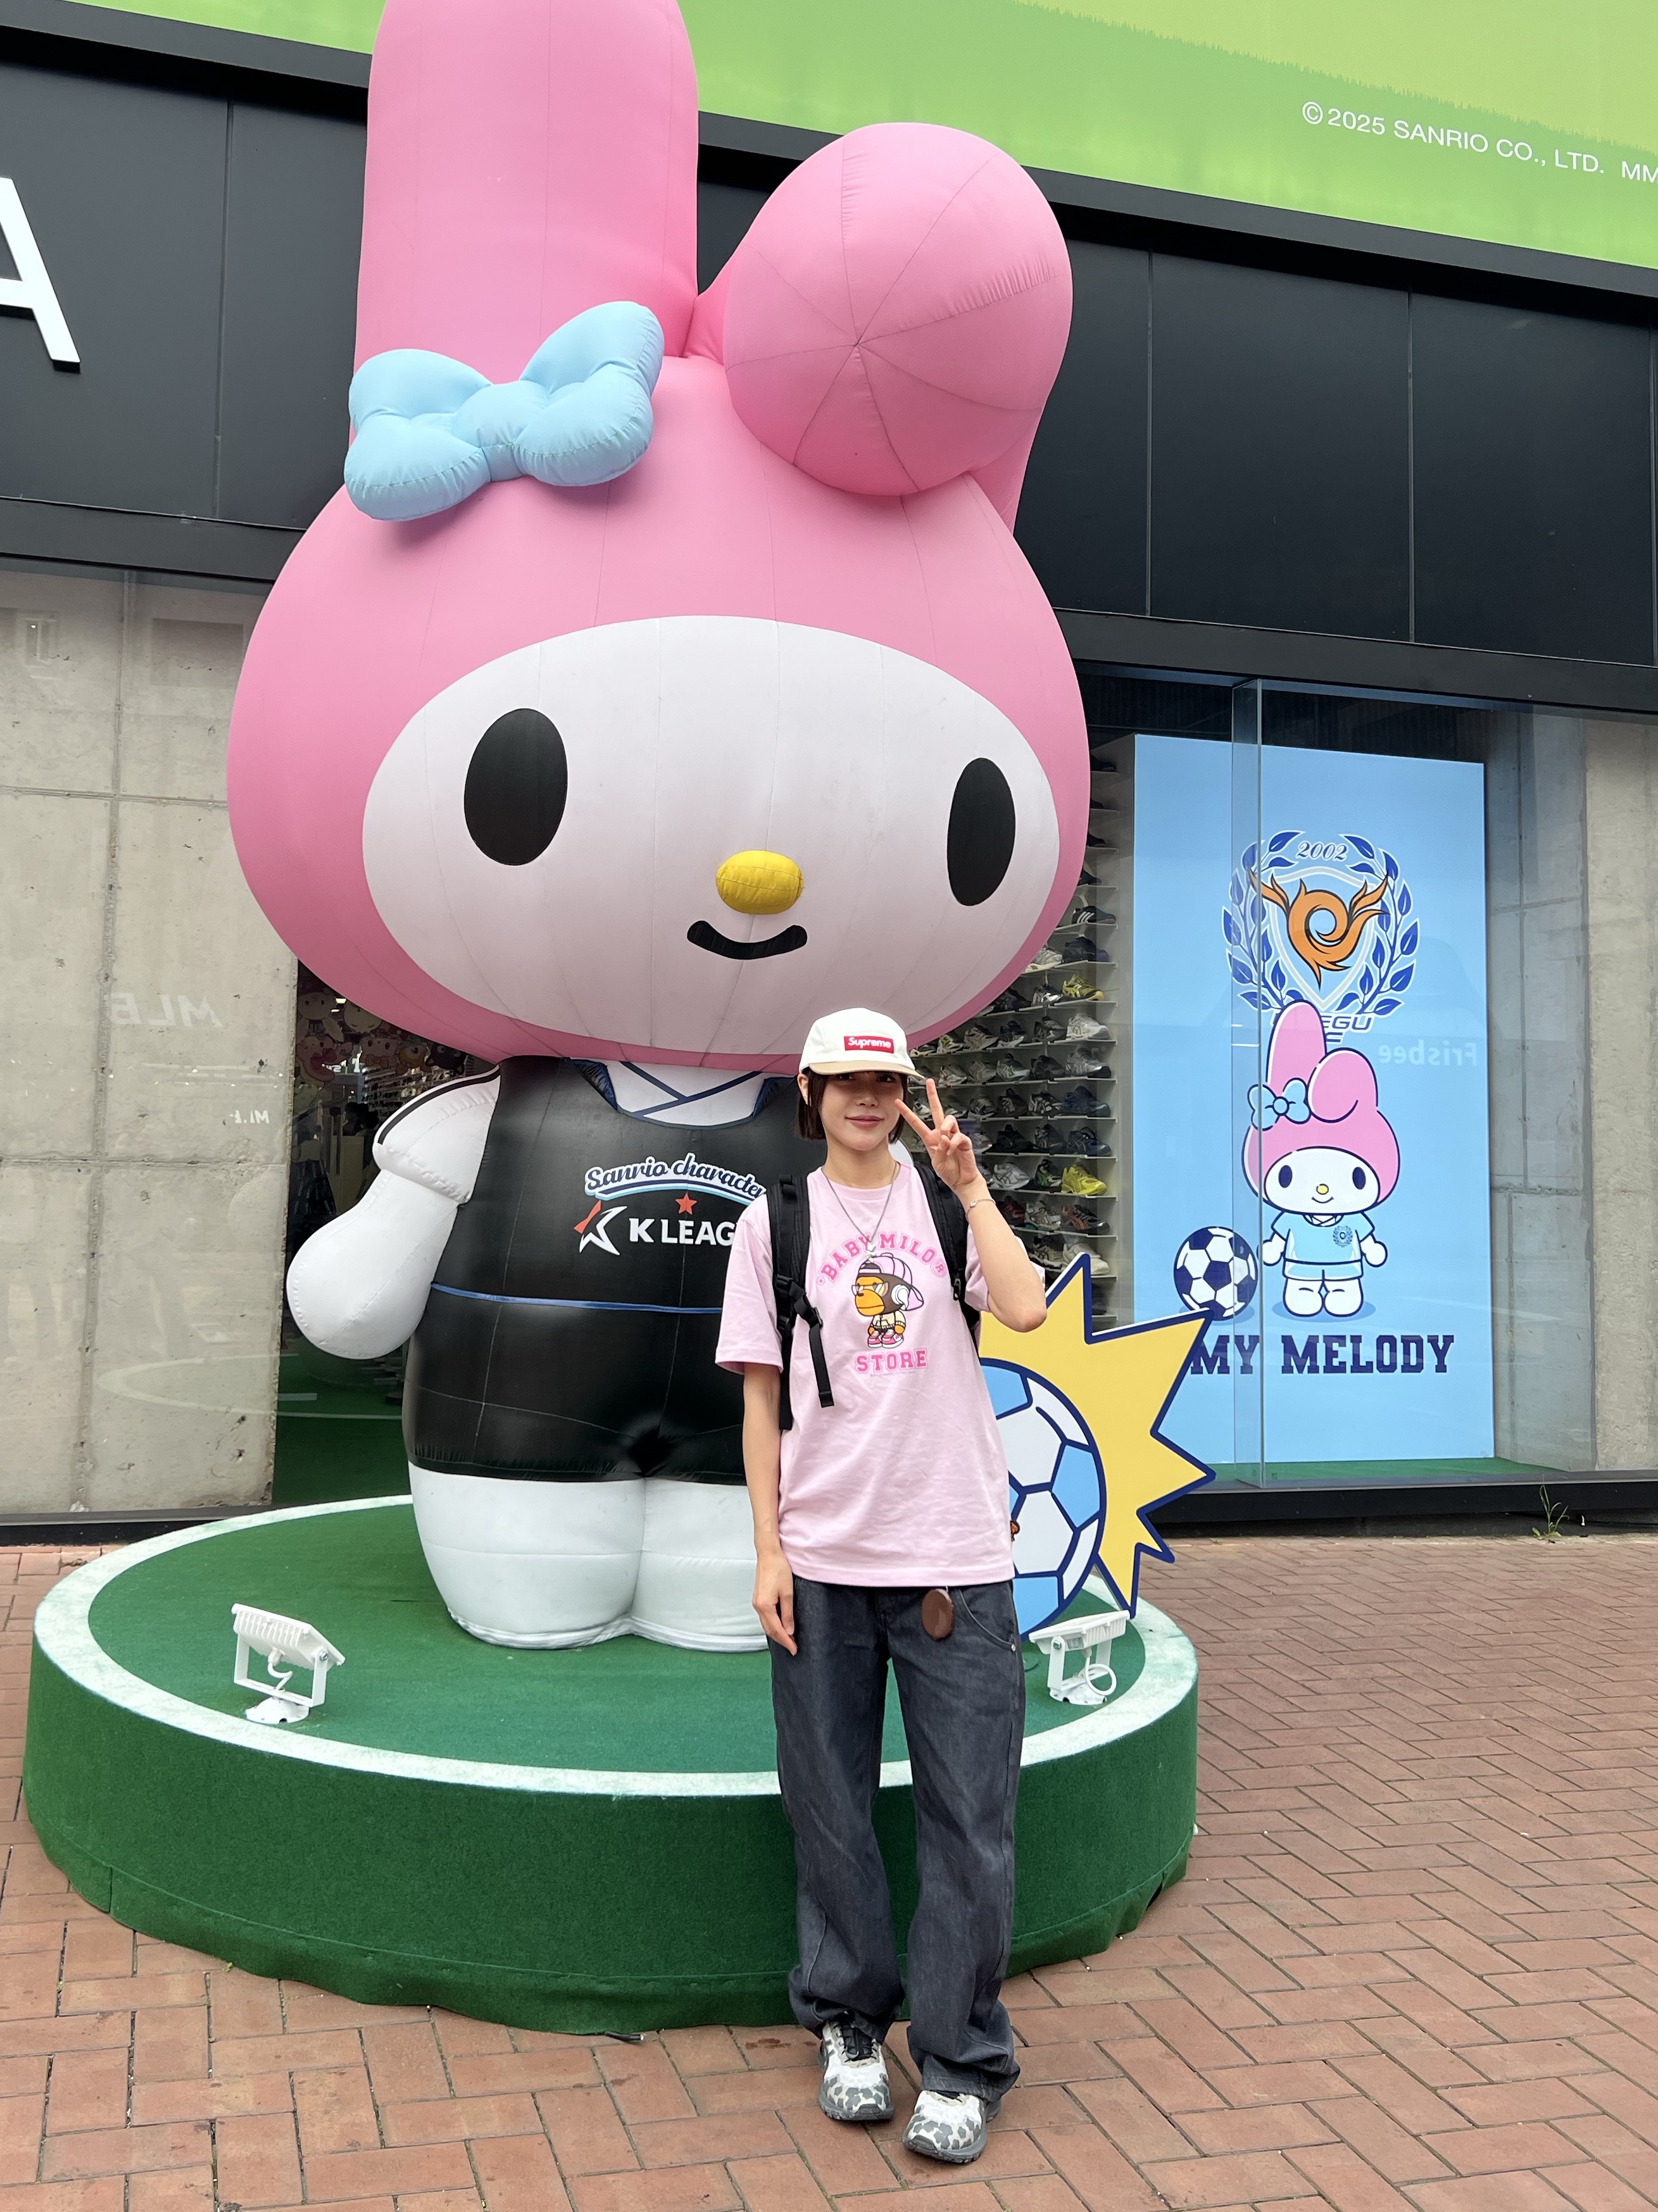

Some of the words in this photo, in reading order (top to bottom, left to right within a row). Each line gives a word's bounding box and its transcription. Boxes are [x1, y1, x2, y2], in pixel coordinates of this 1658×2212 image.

[1393, 120, 1488, 153] SANRIO
[1496, 139, 1546, 166] CO.,
[1555, 149, 1605, 174] LTD.
[1297, 842, 1347, 861] 2002
[848, 1037, 891, 1049] Supreme
[587, 1158, 669, 1190] Sanrio
[629, 1218, 655, 1243] K
[661, 1219, 738, 1247] LEAG
[820, 1234, 872, 1281] BABY
[855, 1349, 927, 1373] STORE
[1190, 1335, 1260, 1374] MY
[1281, 1334, 1455, 1373] MELODY
